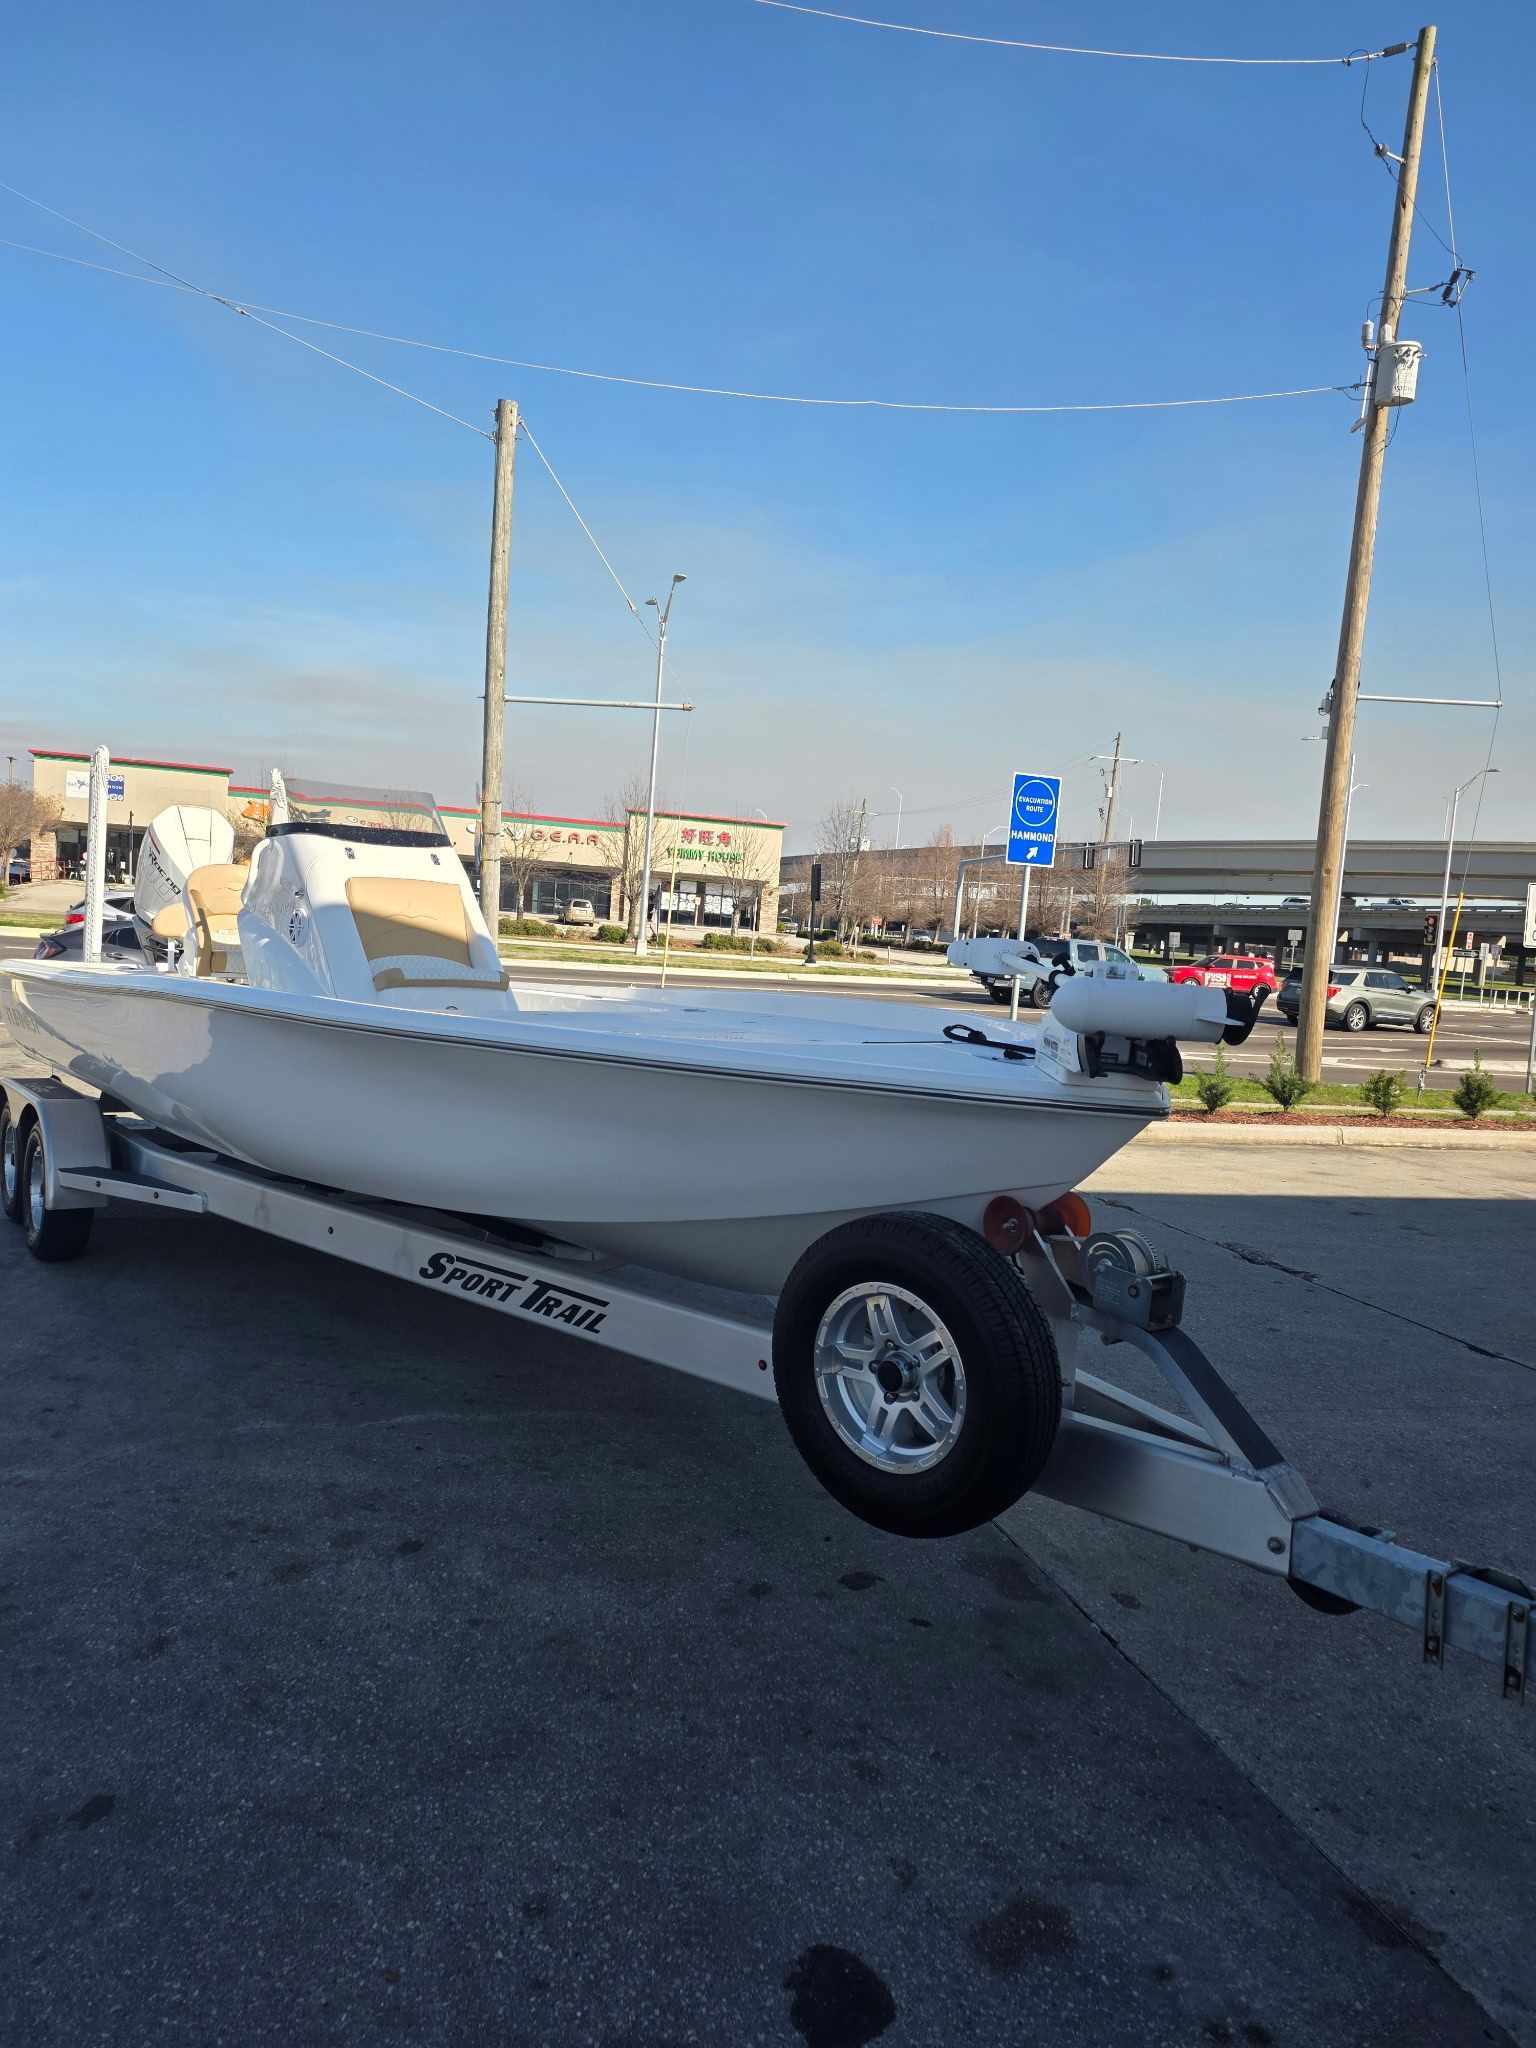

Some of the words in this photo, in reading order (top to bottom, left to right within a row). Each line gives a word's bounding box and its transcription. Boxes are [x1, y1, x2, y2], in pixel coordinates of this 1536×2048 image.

[1018, 795, 1053, 805] EVACUATION
[1025, 804, 1044, 813] ROUTE
[1011, 830, 1054, 843] HAMMOND
[149, 850, 181, 896] Racng
[419, 1252, 526, 1302] SPORT
[519, 1279, 610, 1334] TRAIL
